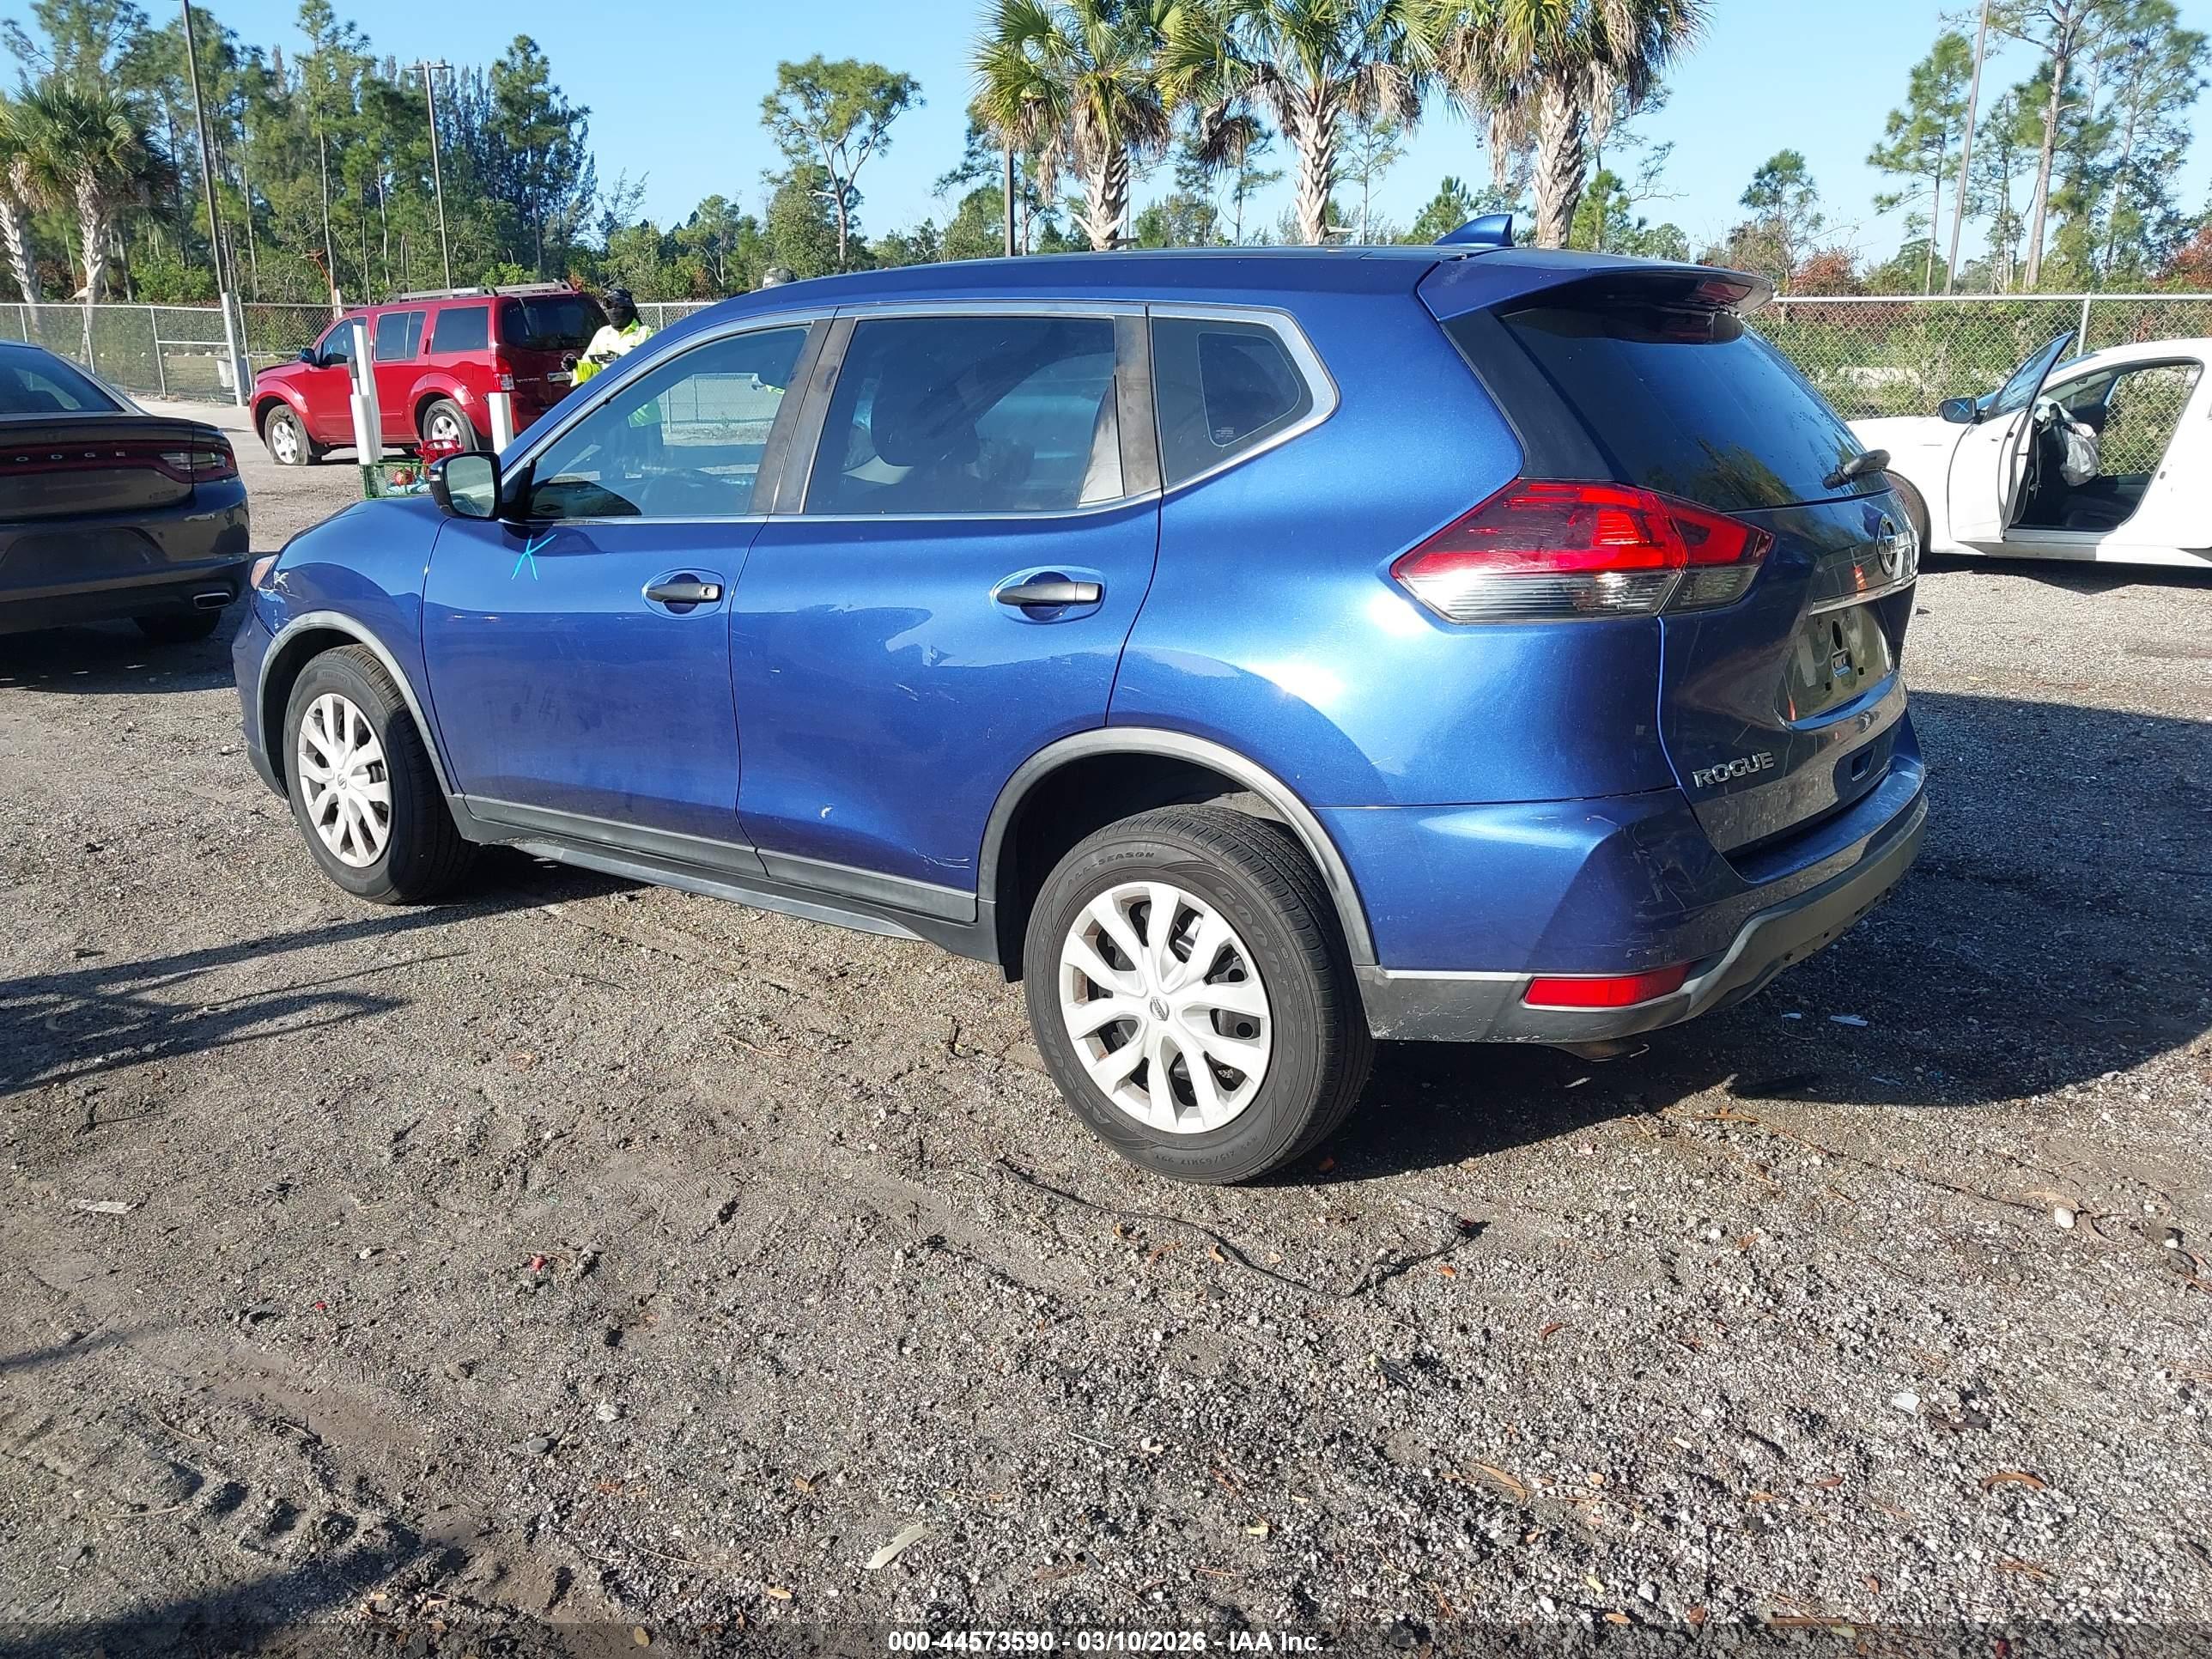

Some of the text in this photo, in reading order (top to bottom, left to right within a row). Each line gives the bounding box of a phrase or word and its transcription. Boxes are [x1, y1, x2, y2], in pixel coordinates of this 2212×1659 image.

[15, 450, 126, 462] ODGE
[1692, 751, 1775, 788] ROGUE
[1066, 851, 1155, 887] ALL-SEASON
